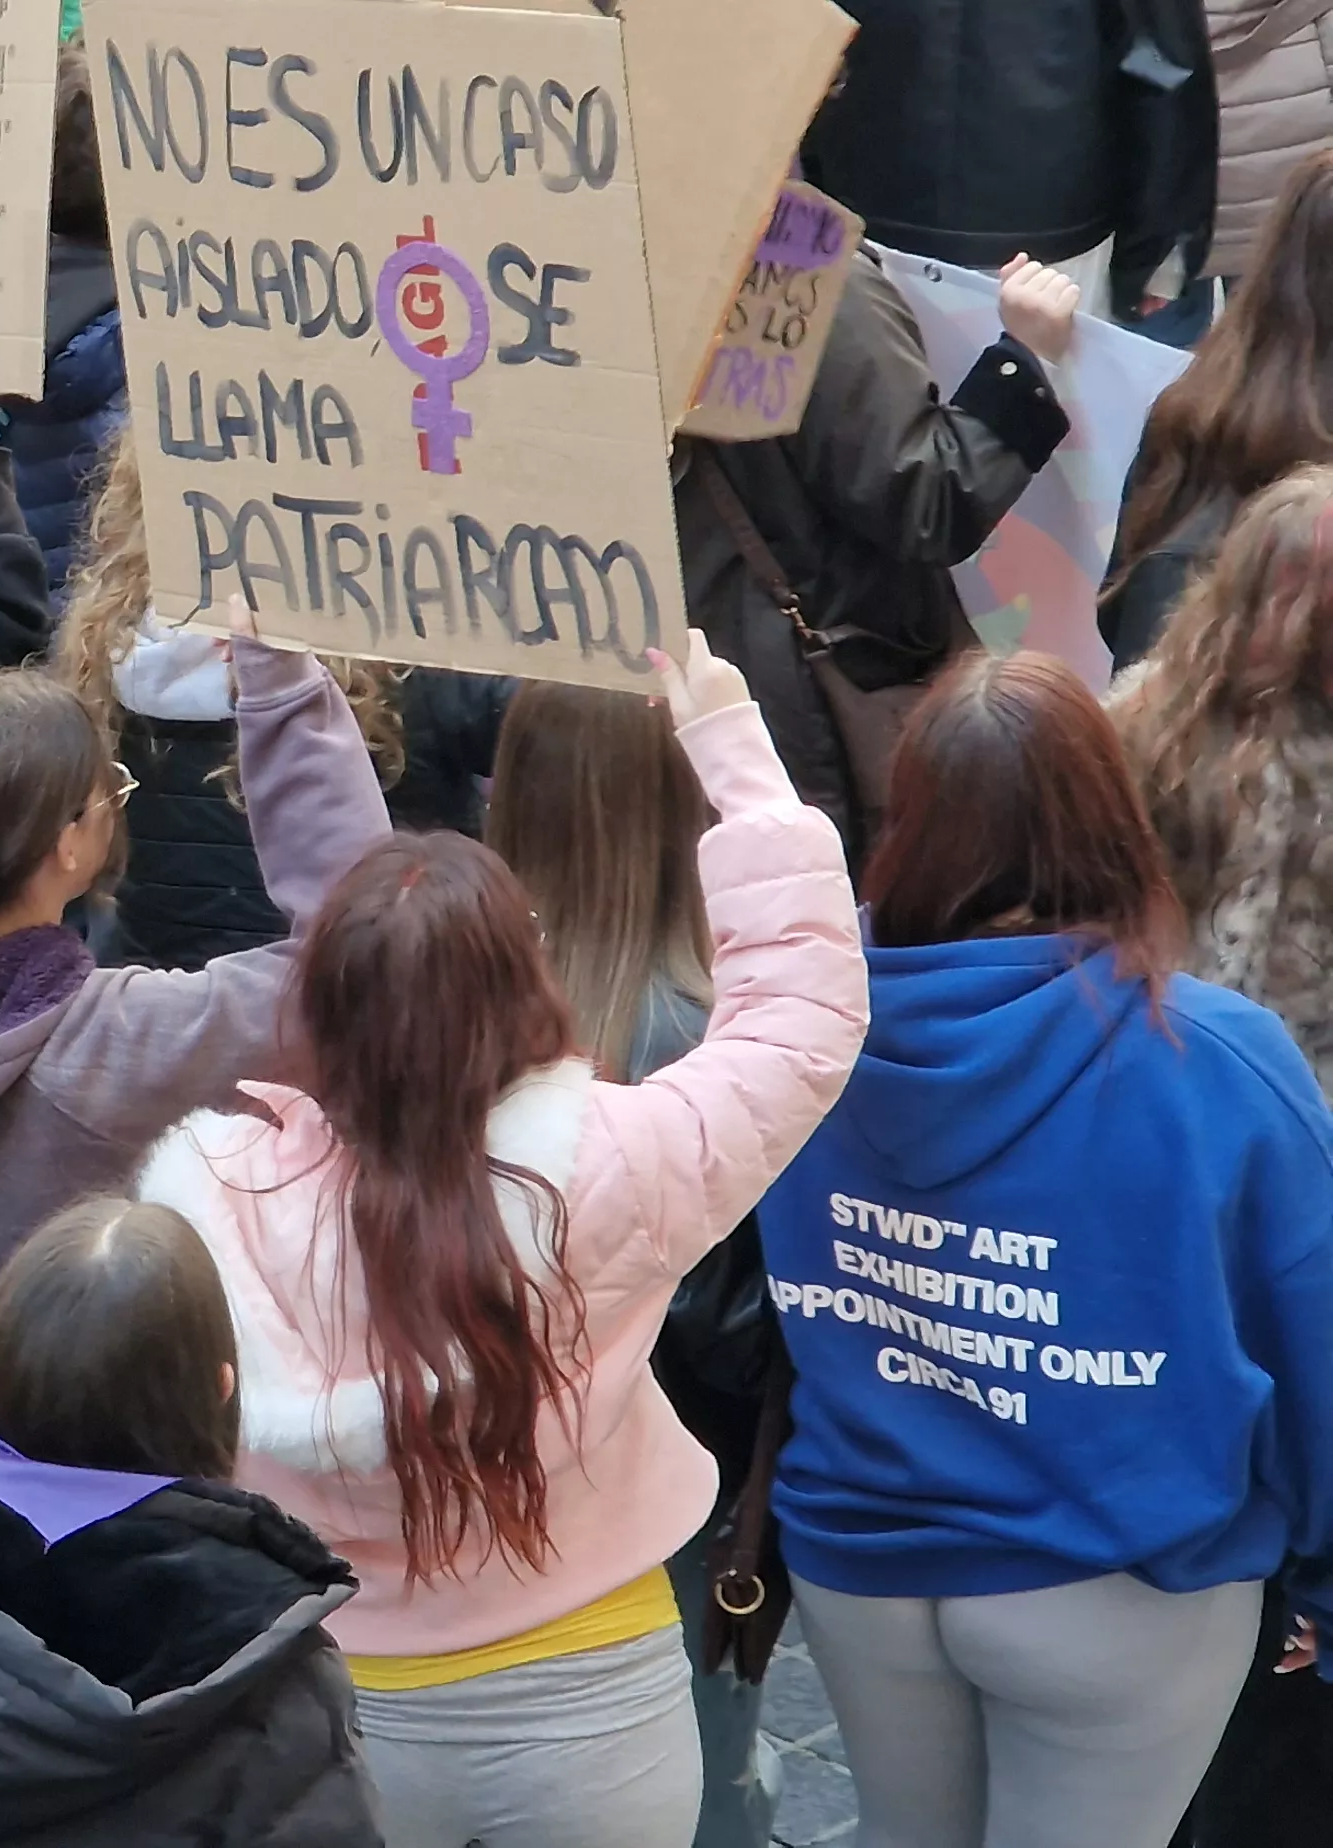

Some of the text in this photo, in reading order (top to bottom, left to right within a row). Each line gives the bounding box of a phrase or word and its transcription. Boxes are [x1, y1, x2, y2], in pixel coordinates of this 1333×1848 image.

[106, 38, 209, 183] NO
[226, 47, 341, 192] ES
[356, 64, 452, 184] UN
[463, 74, 618, 193] CASO
[487, 241, 592, 366] SE
[762, 307, 806, 349] LO
[155, 360, 365, 468] LLAMA
[833, 1240, 1060, 1326] EXHIBITION
[969, 1228, 1058, 1271] ART
[876, 1347, 1030, 1426] CIRCA 91
[1039, 1345, 1168, 1387] ONLY
